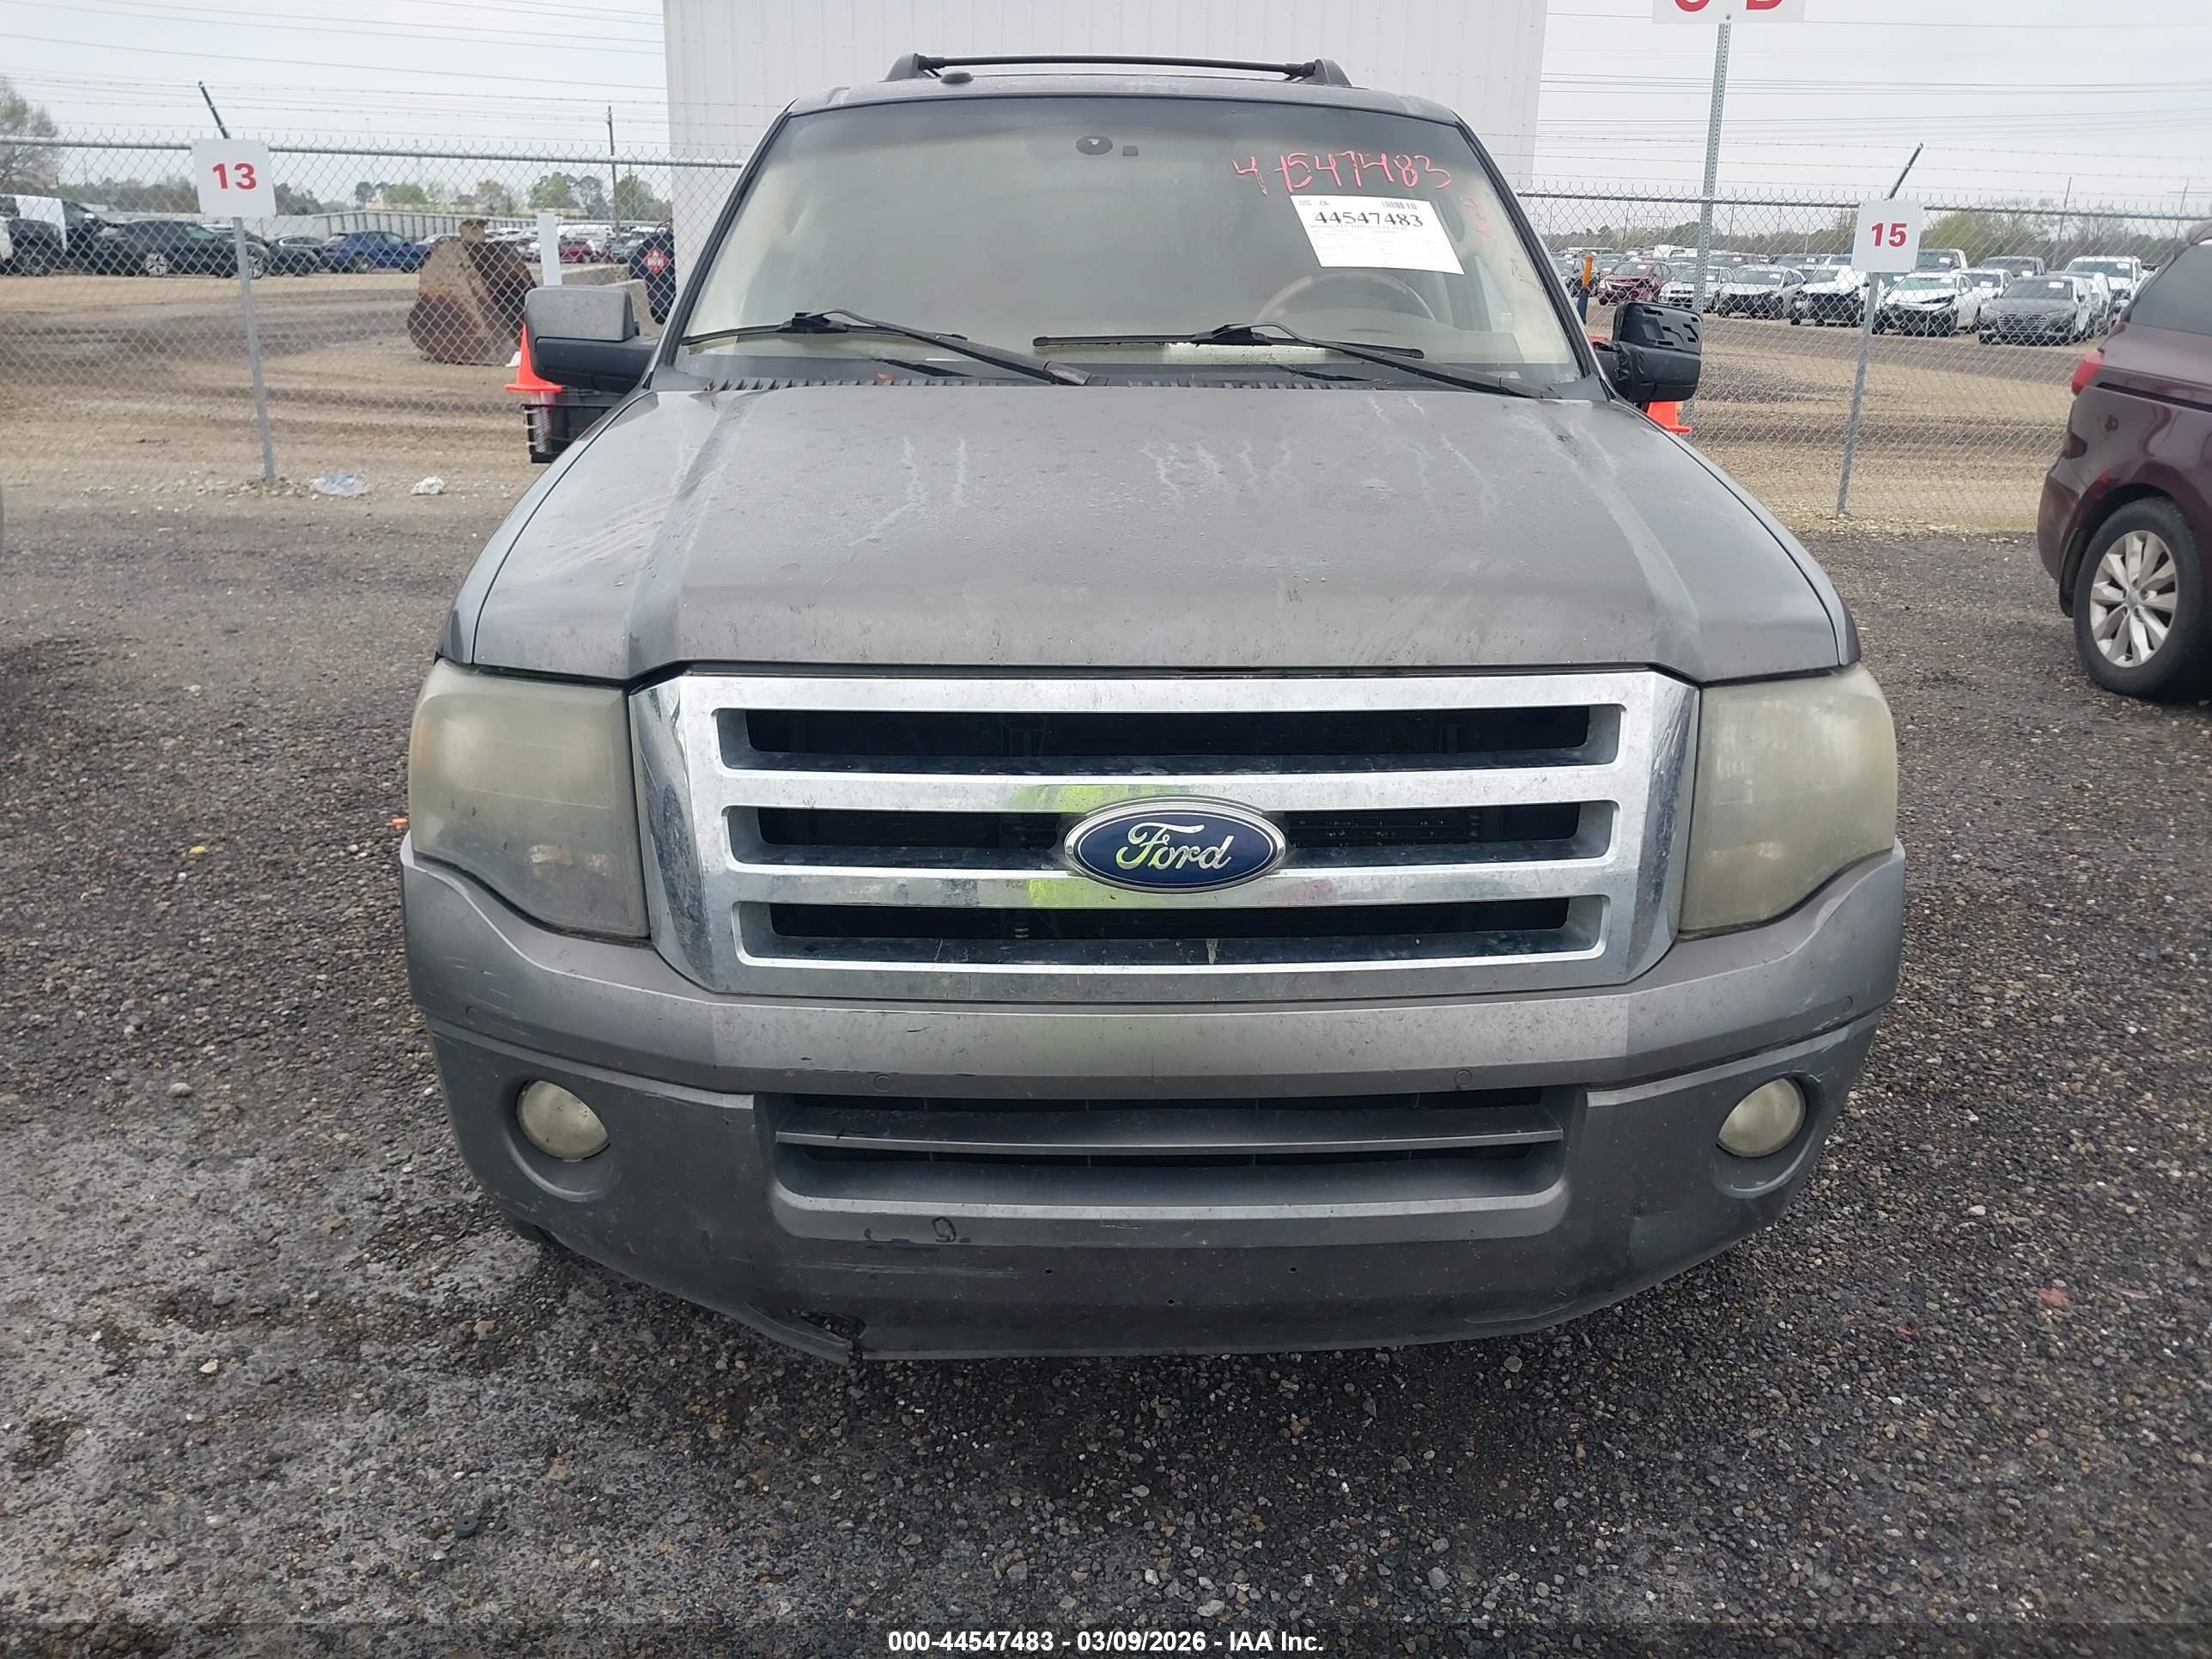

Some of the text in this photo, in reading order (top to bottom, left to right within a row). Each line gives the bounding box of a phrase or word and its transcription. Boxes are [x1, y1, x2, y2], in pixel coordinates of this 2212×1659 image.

[212, 163, 257, 190] 13
[1315, 210, 1424, 228] 44547483
[1871, 222, 1907, 247] 15
[1115, 822, 1235, 870] Ford
